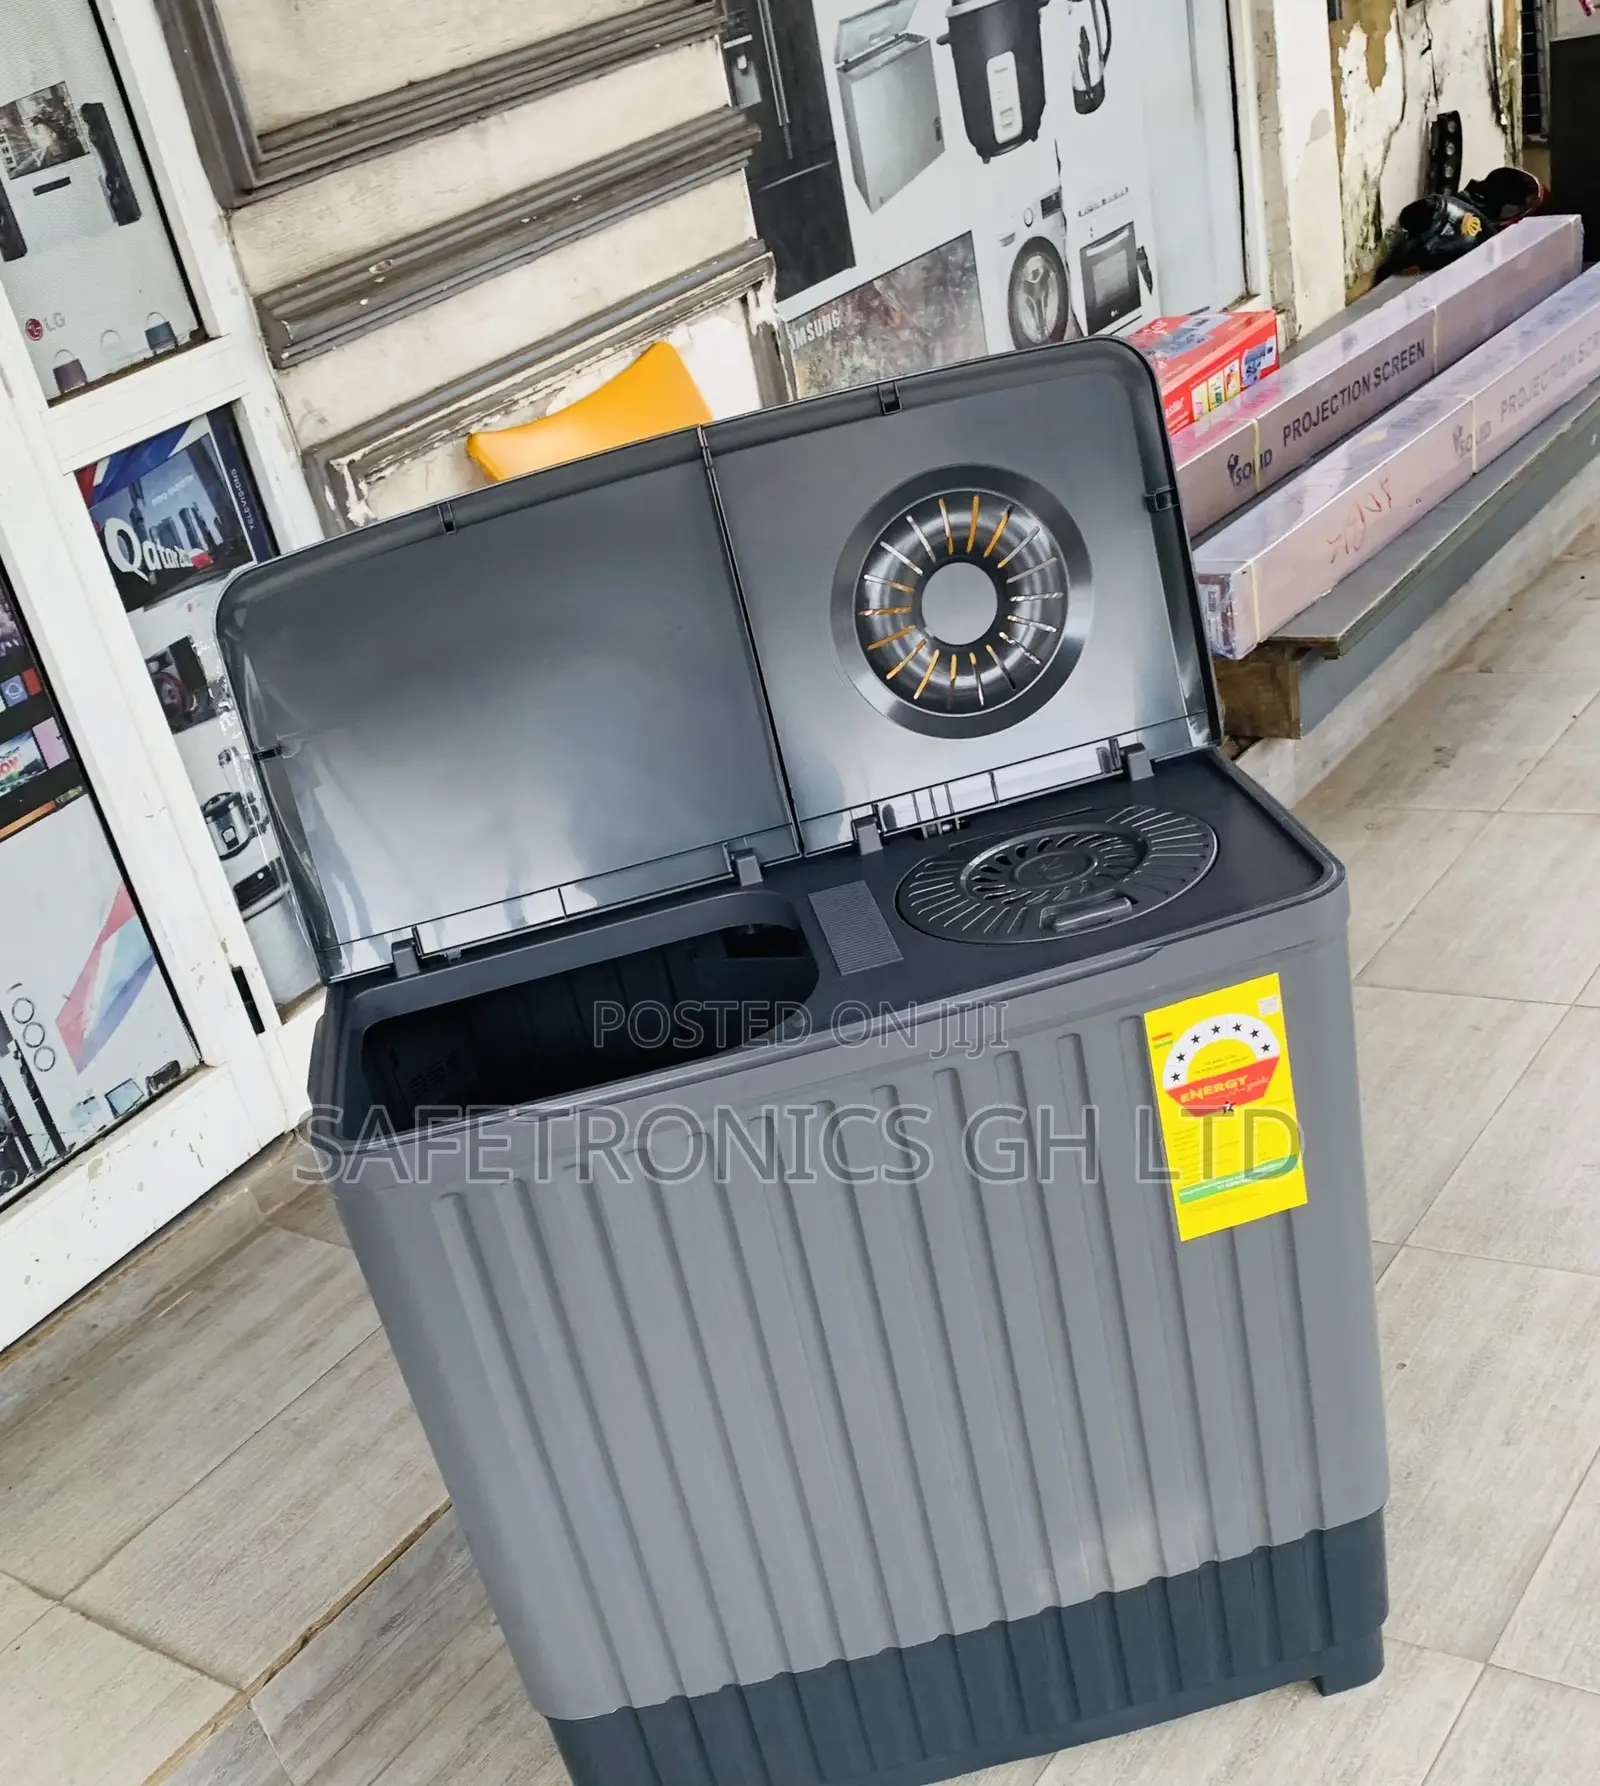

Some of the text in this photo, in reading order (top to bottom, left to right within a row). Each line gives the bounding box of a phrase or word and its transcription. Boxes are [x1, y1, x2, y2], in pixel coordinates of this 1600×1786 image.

[44, 311, 66, 332] LG
[790, 310, 841, 350] MSUNG
[1283, 372, 1371, 447] PROJECTION
[1373, 338, 1426, 388] SCREEN
[1500, 350, 1577, 423] PROJECTION
[1180, 1074, 1249, 1103] ENERGY
